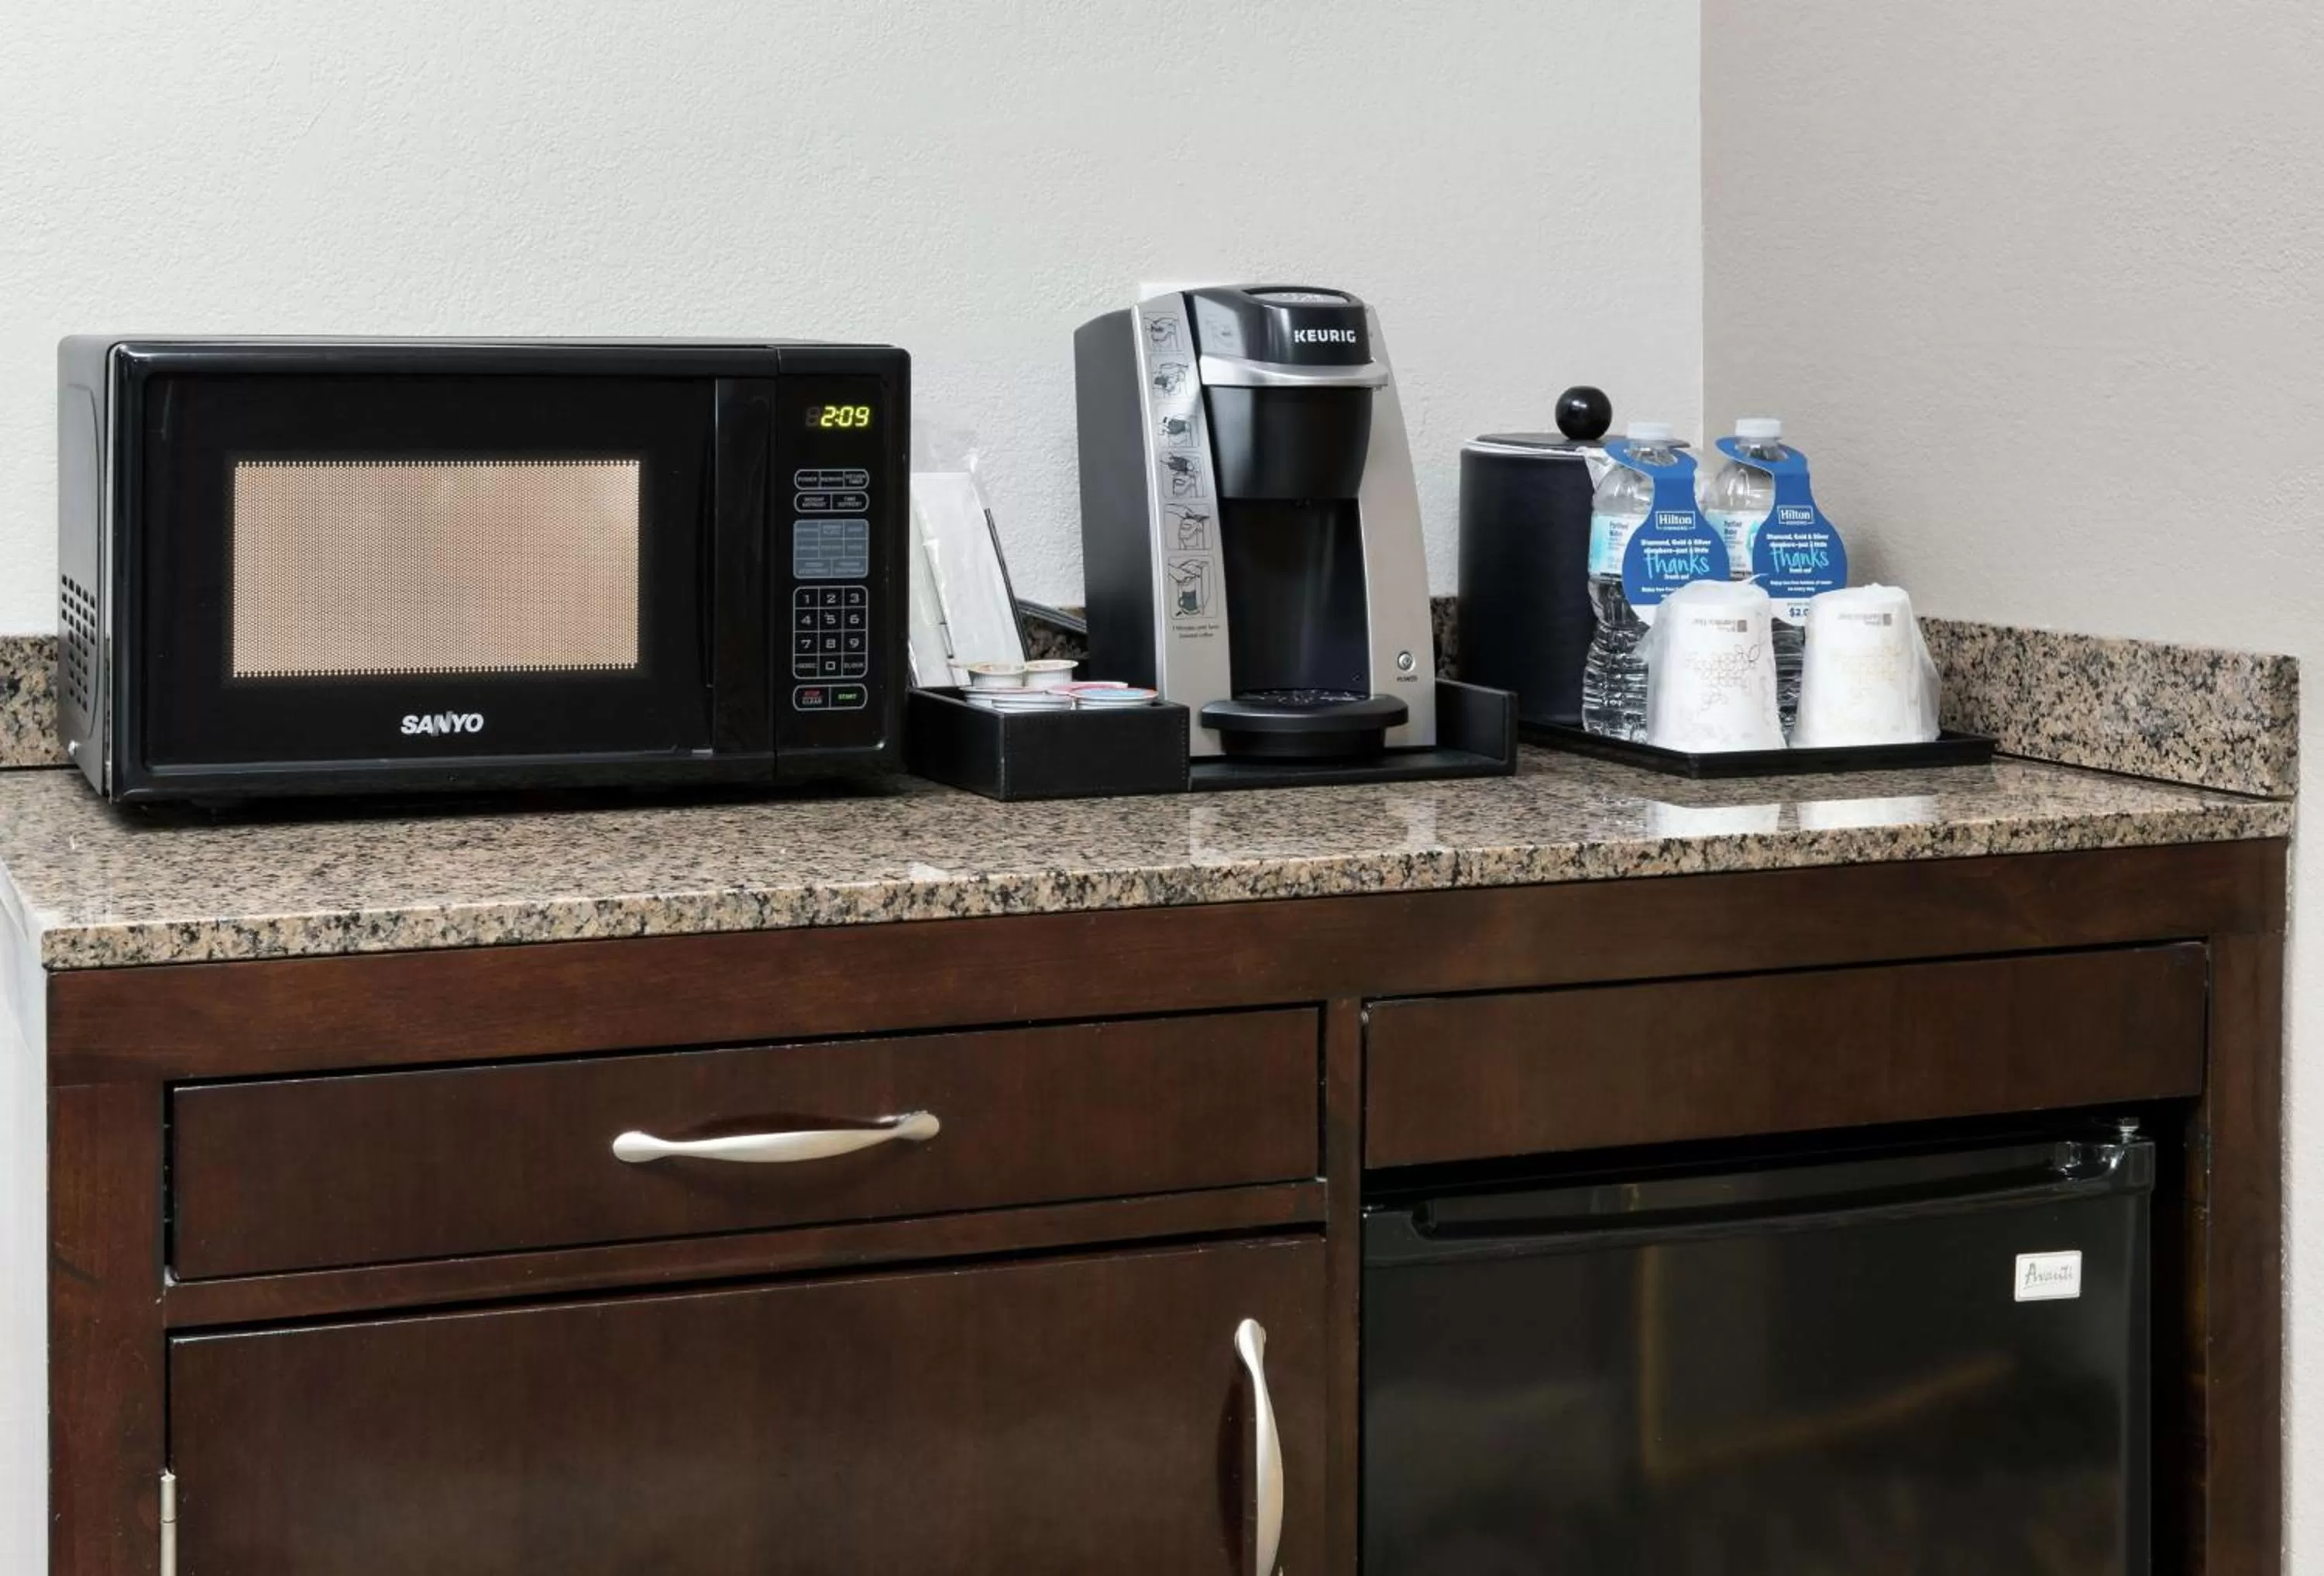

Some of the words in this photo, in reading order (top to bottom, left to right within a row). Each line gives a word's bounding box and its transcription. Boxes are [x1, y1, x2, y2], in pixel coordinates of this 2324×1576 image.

[1294, 329, 1356, 342] KEURIG
[821, 405, 870, 427] 2:09
[1659, 514, 1693, 525] Hilton
[1781, 508, 1811, 521] Hilton
[1643, 548, 1710, 580] Thanks
[1770, 542, 1829, 573] Thanks
[805, 594, 810, 604] 1
[827, 594, 836, 604] 2
[850, 593, 859, 603] 3
[801, 615, 811, 625] 4
[826, 614, 836, 625] 5
[850, 614, 859, 624] 6
[801, 639, 811, 649] 7
[825, 638, 836, 649] 8
[850, 638, 859, 649] 9
[825, 661, 836, 670] 0
[401, 711, 484, 736] SANYO
